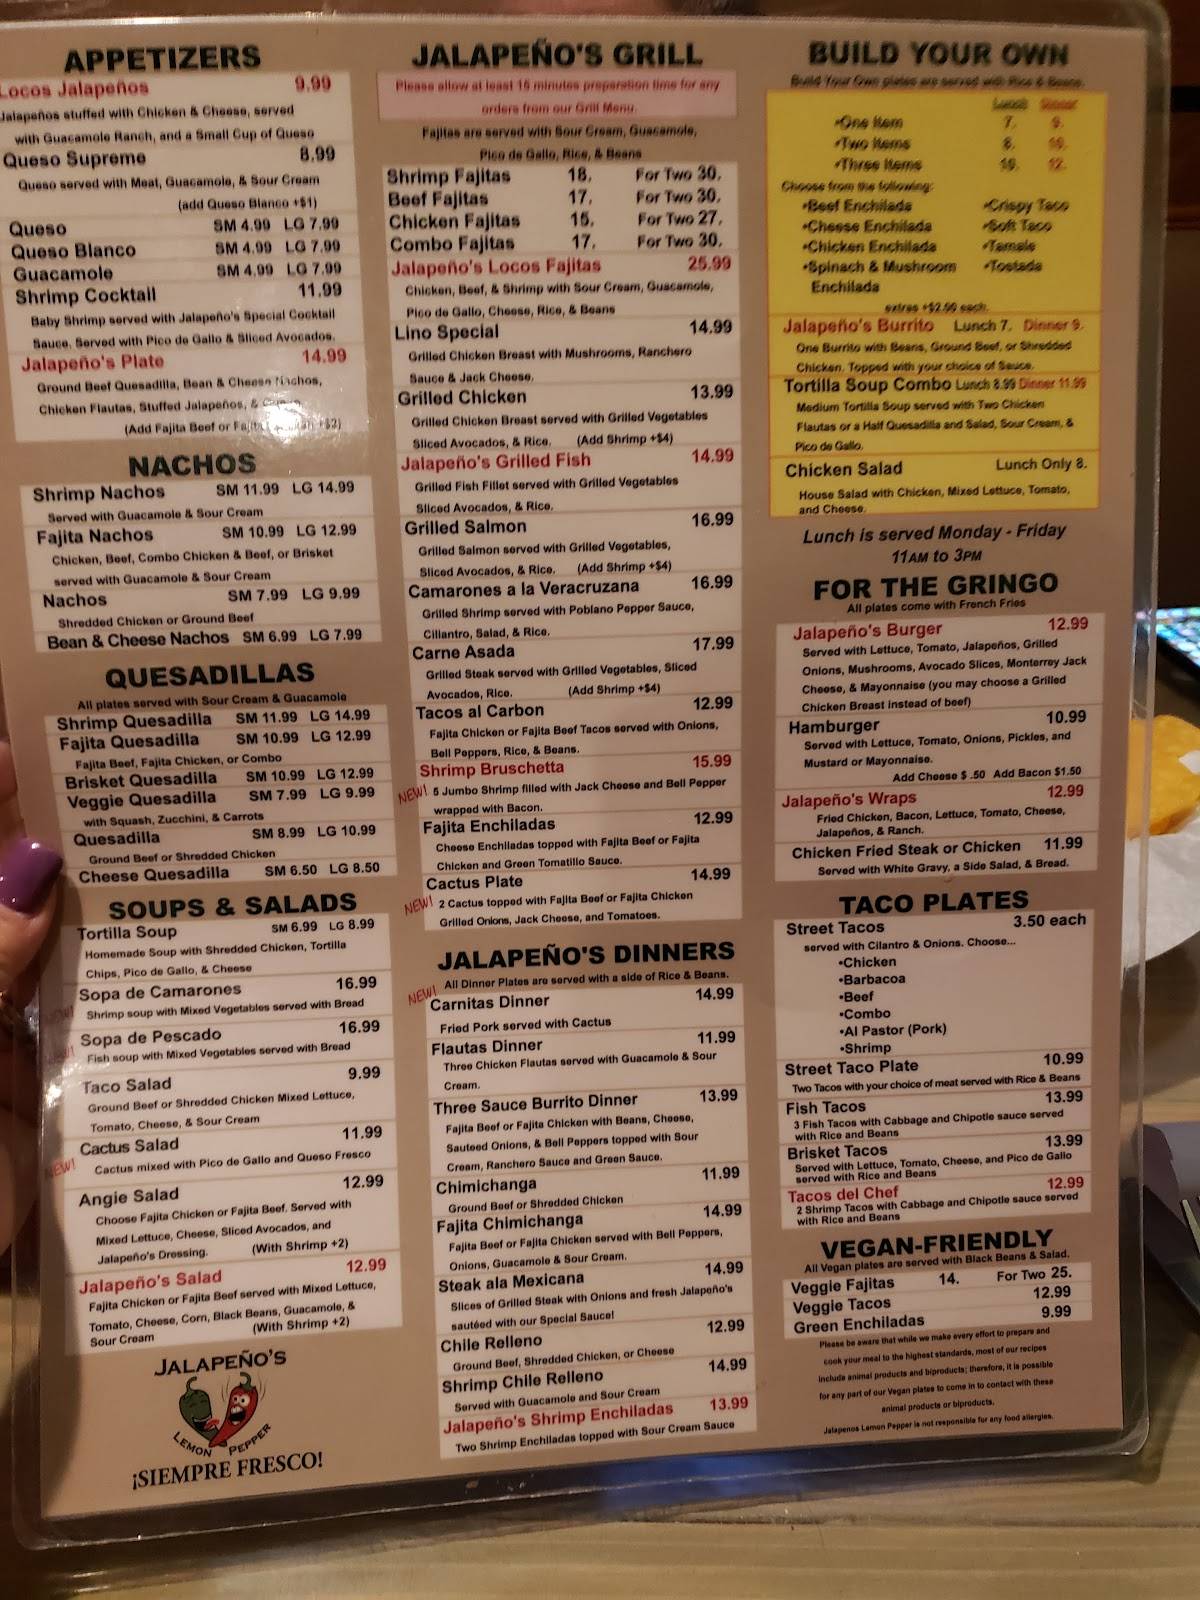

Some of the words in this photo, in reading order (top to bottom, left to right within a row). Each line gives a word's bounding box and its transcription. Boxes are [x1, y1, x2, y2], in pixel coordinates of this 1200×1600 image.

[63, 44, 261, 74] APPETIZERS
[411, 37, 603, 69] JALAPEÑO'S
[612, 42, 703, 68] GRILL
[808, 40, 900, 66] BUILD
[910, 41, 992, 67] YOUR
[1000, 43, 1069, 67] OWN
[57, 80, 149, 100] Jalapeños
[294, 75, 331, 92] 9.99
[18, 179, 56, 192] Queso
[59, 178, 99, 190] served
[102, 177, 127, 189] with
[130, 176, 162, 190] Meat,
[165, 175, 235, 189] Guacamole,
[238, 175, 247, 187] &
[250, 174, 278, 186] Sour
[281, 174, 320, 185] Cream
[387, 168, 449, 188] Shrimp
[454, 167, 511, 187] Fajitas
[568, 166, 592, 182] 18.
[635, 167, 660, 182] For
[664, 167, 692, 181] Two
[697, 165, 721, 181] 30.
[11, 243, 69, 261] Queso
[74, 242, 136, 258] Blanco
[215, 241, 238, 255] SM
[242, 241, 272, 255] 4.99
[285, 239, 306, 253] LG
[311, 239, 341, 253] 7.99
[391, 259, 483, 279] Jalapeño's
[488, 258, 540, 274] Locos
[546, 256, 601, 276] Fajitas
[688, 255, 731, 271] 25.99
[782, 317, 872, 337] Jalapeño's
[877, 317, 934, 333] Burrito
[953, 319, 997, 333] Lunch
[1000, 319, 1012, 332] 7.
[1023, 318, 1069, 332] Dinner
[1071, 318, 1084, 331] 9.
[21, 354, 116, 375] Jalapeño's
[121, 353, 164, 369] Plate
[302, 347, 347, 364] 14.99
[128, 452, 256, 478] NACHOS
[785, 462, 852, 478] Chicken
[857, 460, 903, 476] Salad
[996, 457, 1038, 471] Lunch
[1041, 457, 1072, 472] Only
[1075, 456, 1087, 469] 8.
[33, 486, 95, 504] Shrimp
[100, 484, 165, 500] Nachos
[216, 483, 239, 497] SM
[243, 482, 279, 496] 11.99
[292, 481, 313, 494] LG
[318, 480, 354, 494] 14.99
[47, 512, 87, 523] Served
[90, 511, 114, 522] with
[117, 508, 181, 521] Guacamole
[184, 508, 193, 519] &
[196, 508, 223, 519] Sour
[226, 507, 263, 518] Cream
[802, 527, 855, 544] Lunch
[859, 527, 874, 542] is
[878, 525, 935, 542] served
[937, 524, 1003, 542] Monday
[1016, 522, 1067, 540] Friday
[891, 549, 929, 564] 11AM
[933, 549, 949, 563] to
[953, 547, 982, 562] 3PM
[408, 584, 502, 599] Camarones
[506, 585, 516, 596] a
[521, 581, 535, 596] la
[539, 580, 639, 595] Veracruzana
[691, 574, 733, 590] 16.99
[814, 578, 872, 601] FOR
[880, 575, 938, 598] THE
[947, 572, 1058, 596] GRINGO
[793, 623, 881, 643] Jalapeño's
[886, 622, 942, 639] Burger
[1048, 616, 1089, 631] 12.99
[105, 662, 315, 690] QUESADILLAS
[64, 774, 125, 790] Brisket
[129, 770, 217, 788] Quesadilla
[246, 770, 267, 783] SM
[271, 769, 305, 782] 10.99
[317, 768, 336, 780] LG
[340, 767, 374, 779] 12.99
[419, 763, 476, 779] Shrimp
[480, 760, 564, 776] Bruschetta
[692, 753, 732, 768] 15.99
[892, 772, 915, 782] Add
[917, 771, 958, 781] Cheese
[960, 770, 967, 781] $
[969, 769, 986, 780] .50
[993, 768, 1015, 778] Add
[1017, 768, 1052, 778] Bacon
[1054, 765, 1082, 777] $1.50
[398, 786, 428, 804] NEW!
[83, 817, 107, 827] with
[109, 815, 155, 828] Squash,
[157, 813, 208, 824] Zucchini,
[211, 812, 220, 822] &
[223, 812, 264, 822] Carrots
[108, 898, 205, 920] SOUPS
[215, 897, 236, 917] &
[245, 892, 357, 915] SALADS
[838, 893, 914, 915] TACO
[923, 889, 1029, 912] PLATES
[786, 922, 834, 936] Street
[837, 921, 885, 934] Tacos
[1013, 914, 1045, 928] 3.50
[1049, 912, 1086, 926] each
[437, 943, 605, 971] JALAPEÑO'S
[614, 941, 735, 963] DINNERS
[79, 988, 120, 1004] Sopa
[125, 986, 145, 1000] de
[150, 984, 242, 998] Camarones
[336, 975, 377, 990] 16.99
[430, 996, 494, 1011] Carnitas
[499, 994, 550, 1008] Dinner
[695, 986, 734, 1000] 14.99
[440, 1022, 469, 1034] Fried
[473, 1020, 500, 1032] Pork
[502, 1019, 541, 1031] served
[544, 1018, 569, 1029] with
[571, 1017, 612, 1028] Cactus
[80, 1141, 130, 1156] Cactus
[134, 1136, 179, 1152] Salad
[342, 1124, 382, 1140] 11.99
[787, 1190, 832, 1203] Tacos
[836, 1187, 859, 1201] del
[863, 1185, 899, 1199] Chef
[1047, 1176, 1084, 1190] 12.99
[820, 1228, 1053, 1260] VEGAN-FRIENDLY
[79, 1274, 170, 1295] Jalapeño's
[176, 1269, 222, 1286] Salad
[346, 1257, 386, 1273] 12.99
[790, 1279, 841, 1296] Veggie
[846, 1276, 895, 1293] Fajitas
[939, 1272, 959, 1285] 14.
[997, 1270, 1018, 1282] For
[1020, 1269, 1046, 1280] Two
[1051, 1265, 1072, 1279] 25.
[154, 1349, 287, 1377] JALAPEÑO'S
[443, 1414, 526, 1435] Jalapeño's
[531, 1410, 586, 1426] Shrimp
[590, 1402, 673, 1421] Enchiladas
[710, 1395, 749, 1411] 13.99
[881, 1403, 906, 1413] animal
[908, 1401, 941, 1412] products
[942, 1401, 951, 1409] or
[952, 1398, 995, 1409] biproducts.
[172, 1431, 213, 1457] LEMON
[229, 1423, 272, 1456] PEPPER
[132, 1460, 232, 1490] ¡SIEMPRE
[236, 1451, 322, 1477] FRESCO!
